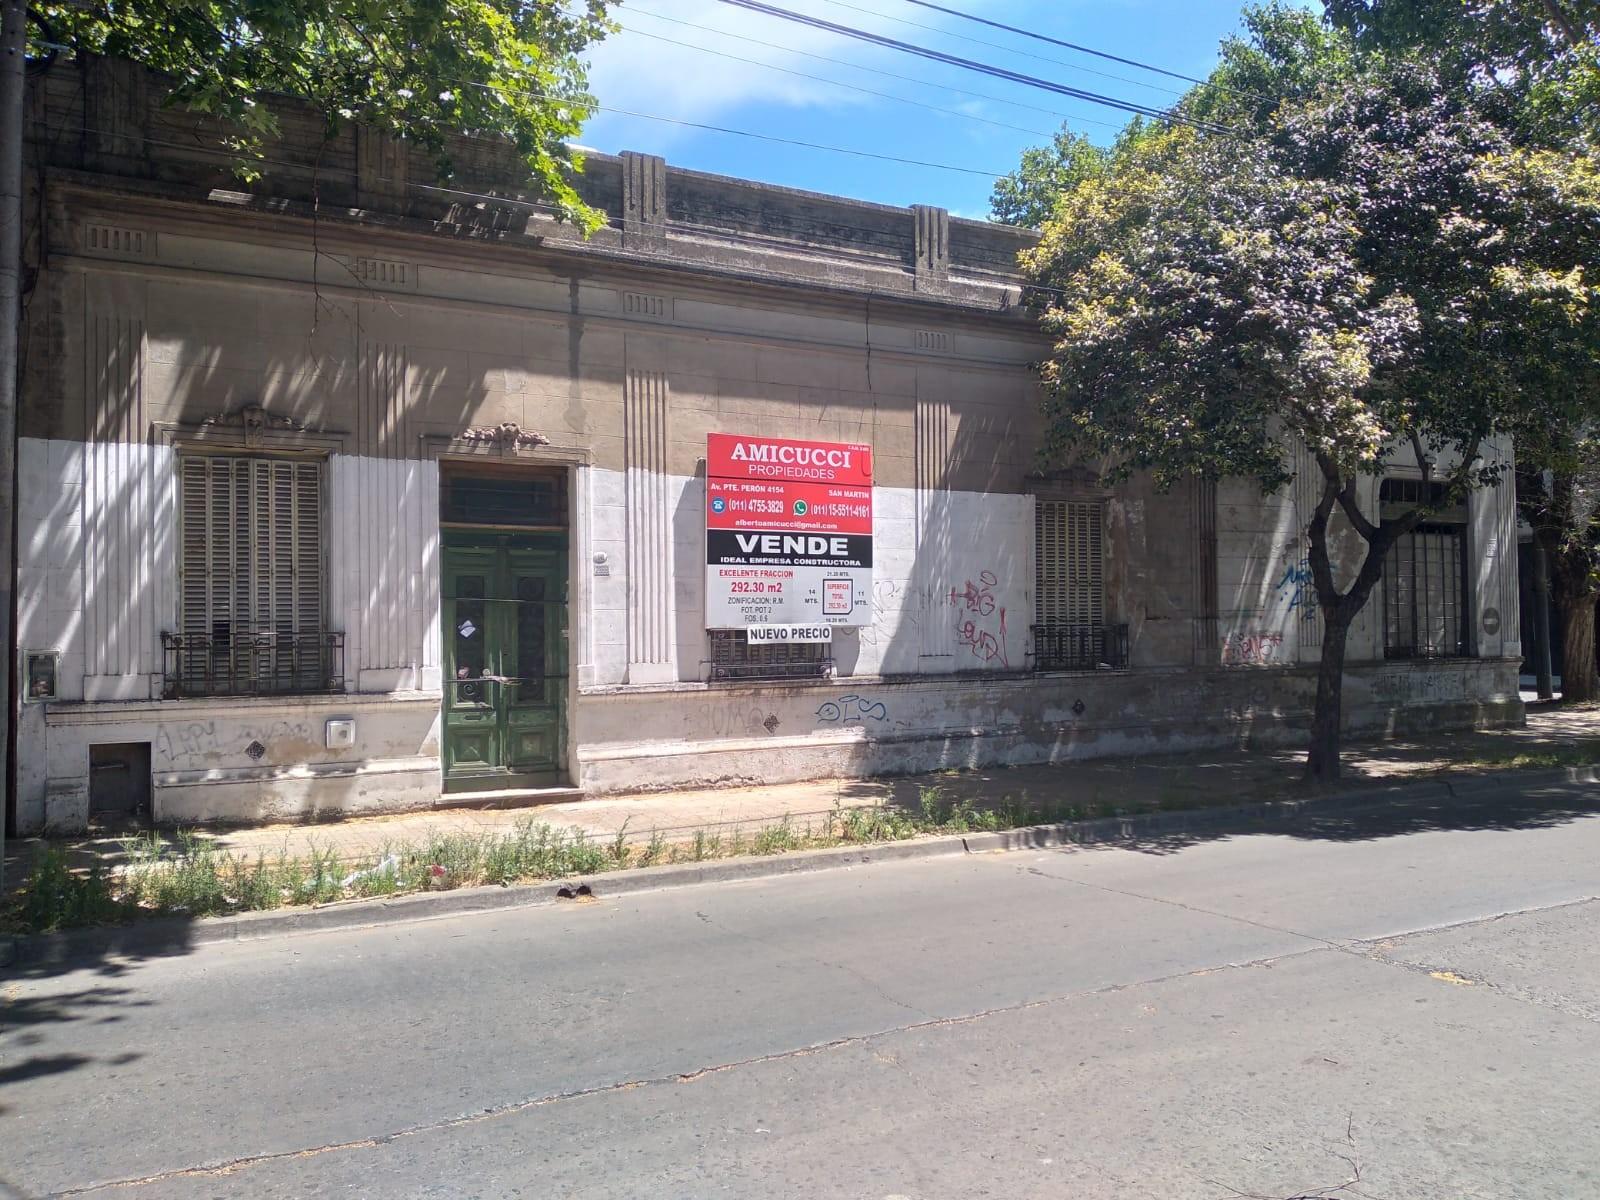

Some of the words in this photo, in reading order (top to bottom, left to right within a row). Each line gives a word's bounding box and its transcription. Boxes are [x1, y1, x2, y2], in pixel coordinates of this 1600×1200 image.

[731, 443, 850, 468] AMICUCCI
[749, 465, 835, 479] PROPIEDADES
[844, 490, 869, 498] MARTIN
[729, 498, 746, 512] (011)
[748, 500, 784, 513] 4755-3829
[811, 503, 828, 516] (011)
[828, 504, 870, 518] 15-5511-4161
[735, 519, 837, 530] albertoamicucci@gmail.com
[735, 534, 849, 556] VENDE
[794, 558, 861, 566] CONSTRUCTORA
[760, 570, 793, 578] FRACCION
[731, 582, 764, 593] 292.30
[768, 582, 782, 593] m2
[750, 628, 788, 640] NUEVO
[792, 628, 830, 639] PRECIO
